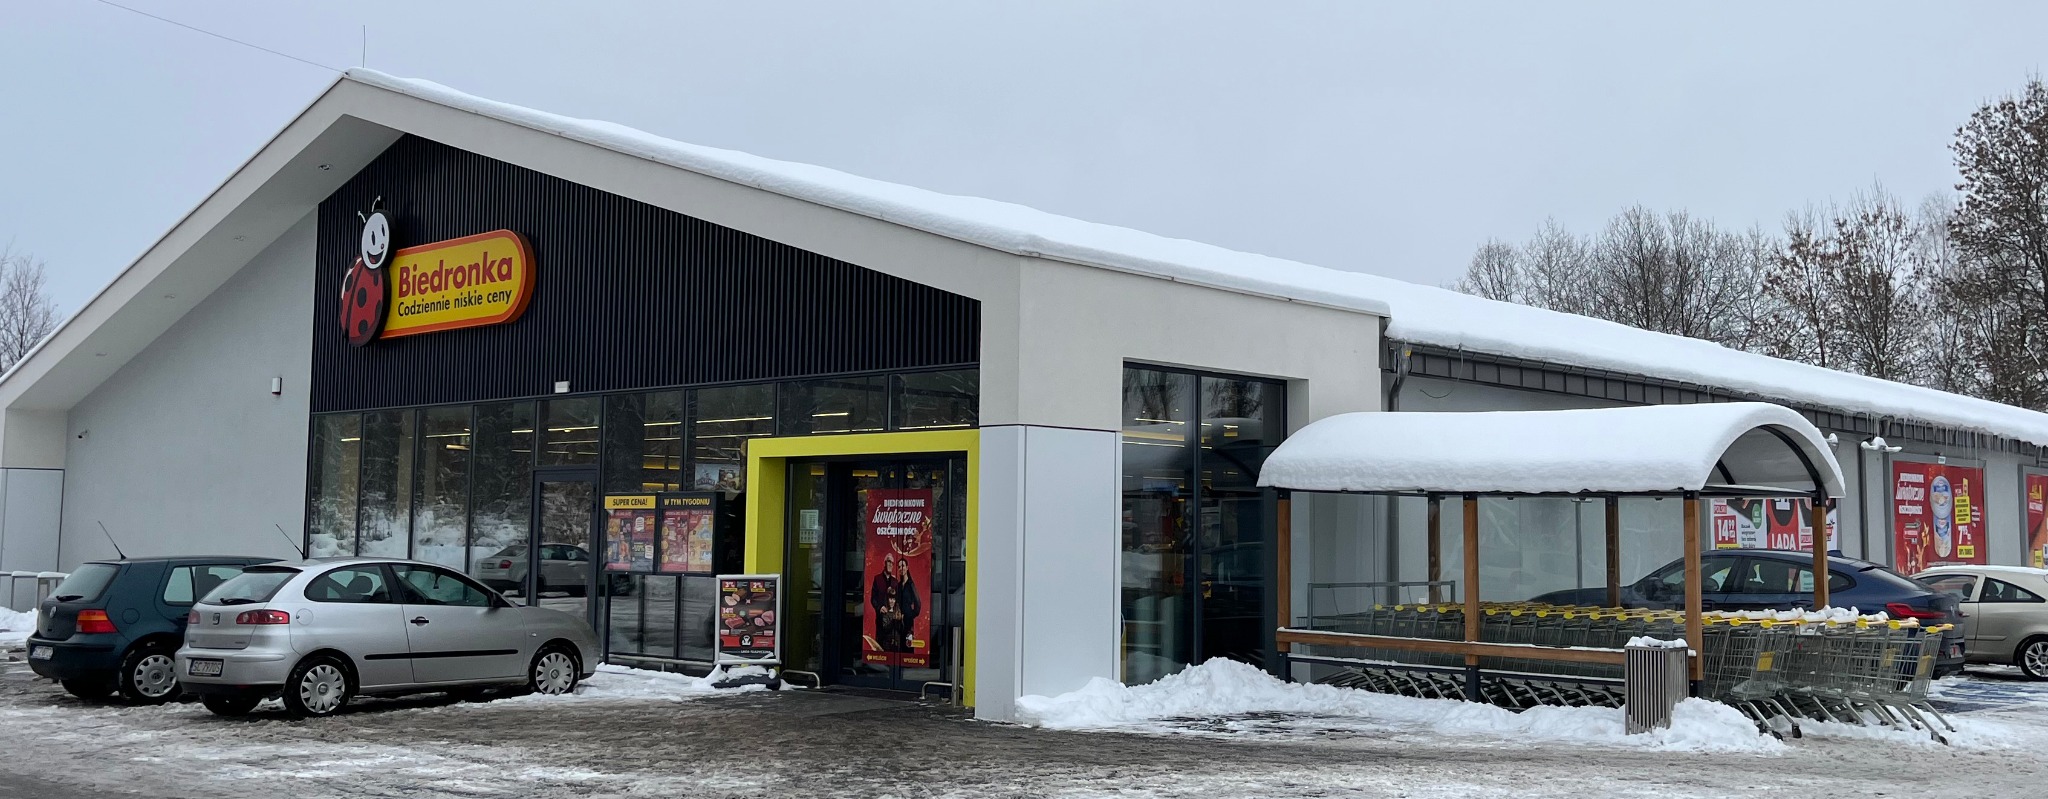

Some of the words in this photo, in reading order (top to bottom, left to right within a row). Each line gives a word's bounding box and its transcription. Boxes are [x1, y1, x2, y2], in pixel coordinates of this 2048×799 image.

[398, 251, 513, 298] Biedronka
[398, 295, 450, 317] Codziennie
[454, 289, 483, 308] niskie
[487, 289, 512, 304] ceny
[612, 498, 630, 506] SUPER
[630, 498, 648, 506] CENA!
[664, 498, 670, 506] W
[670, 498, 682, 506] TYM
[682, 498, 711, 506] TYGODNIU
[1771, 533, 1797, 550] LADA
